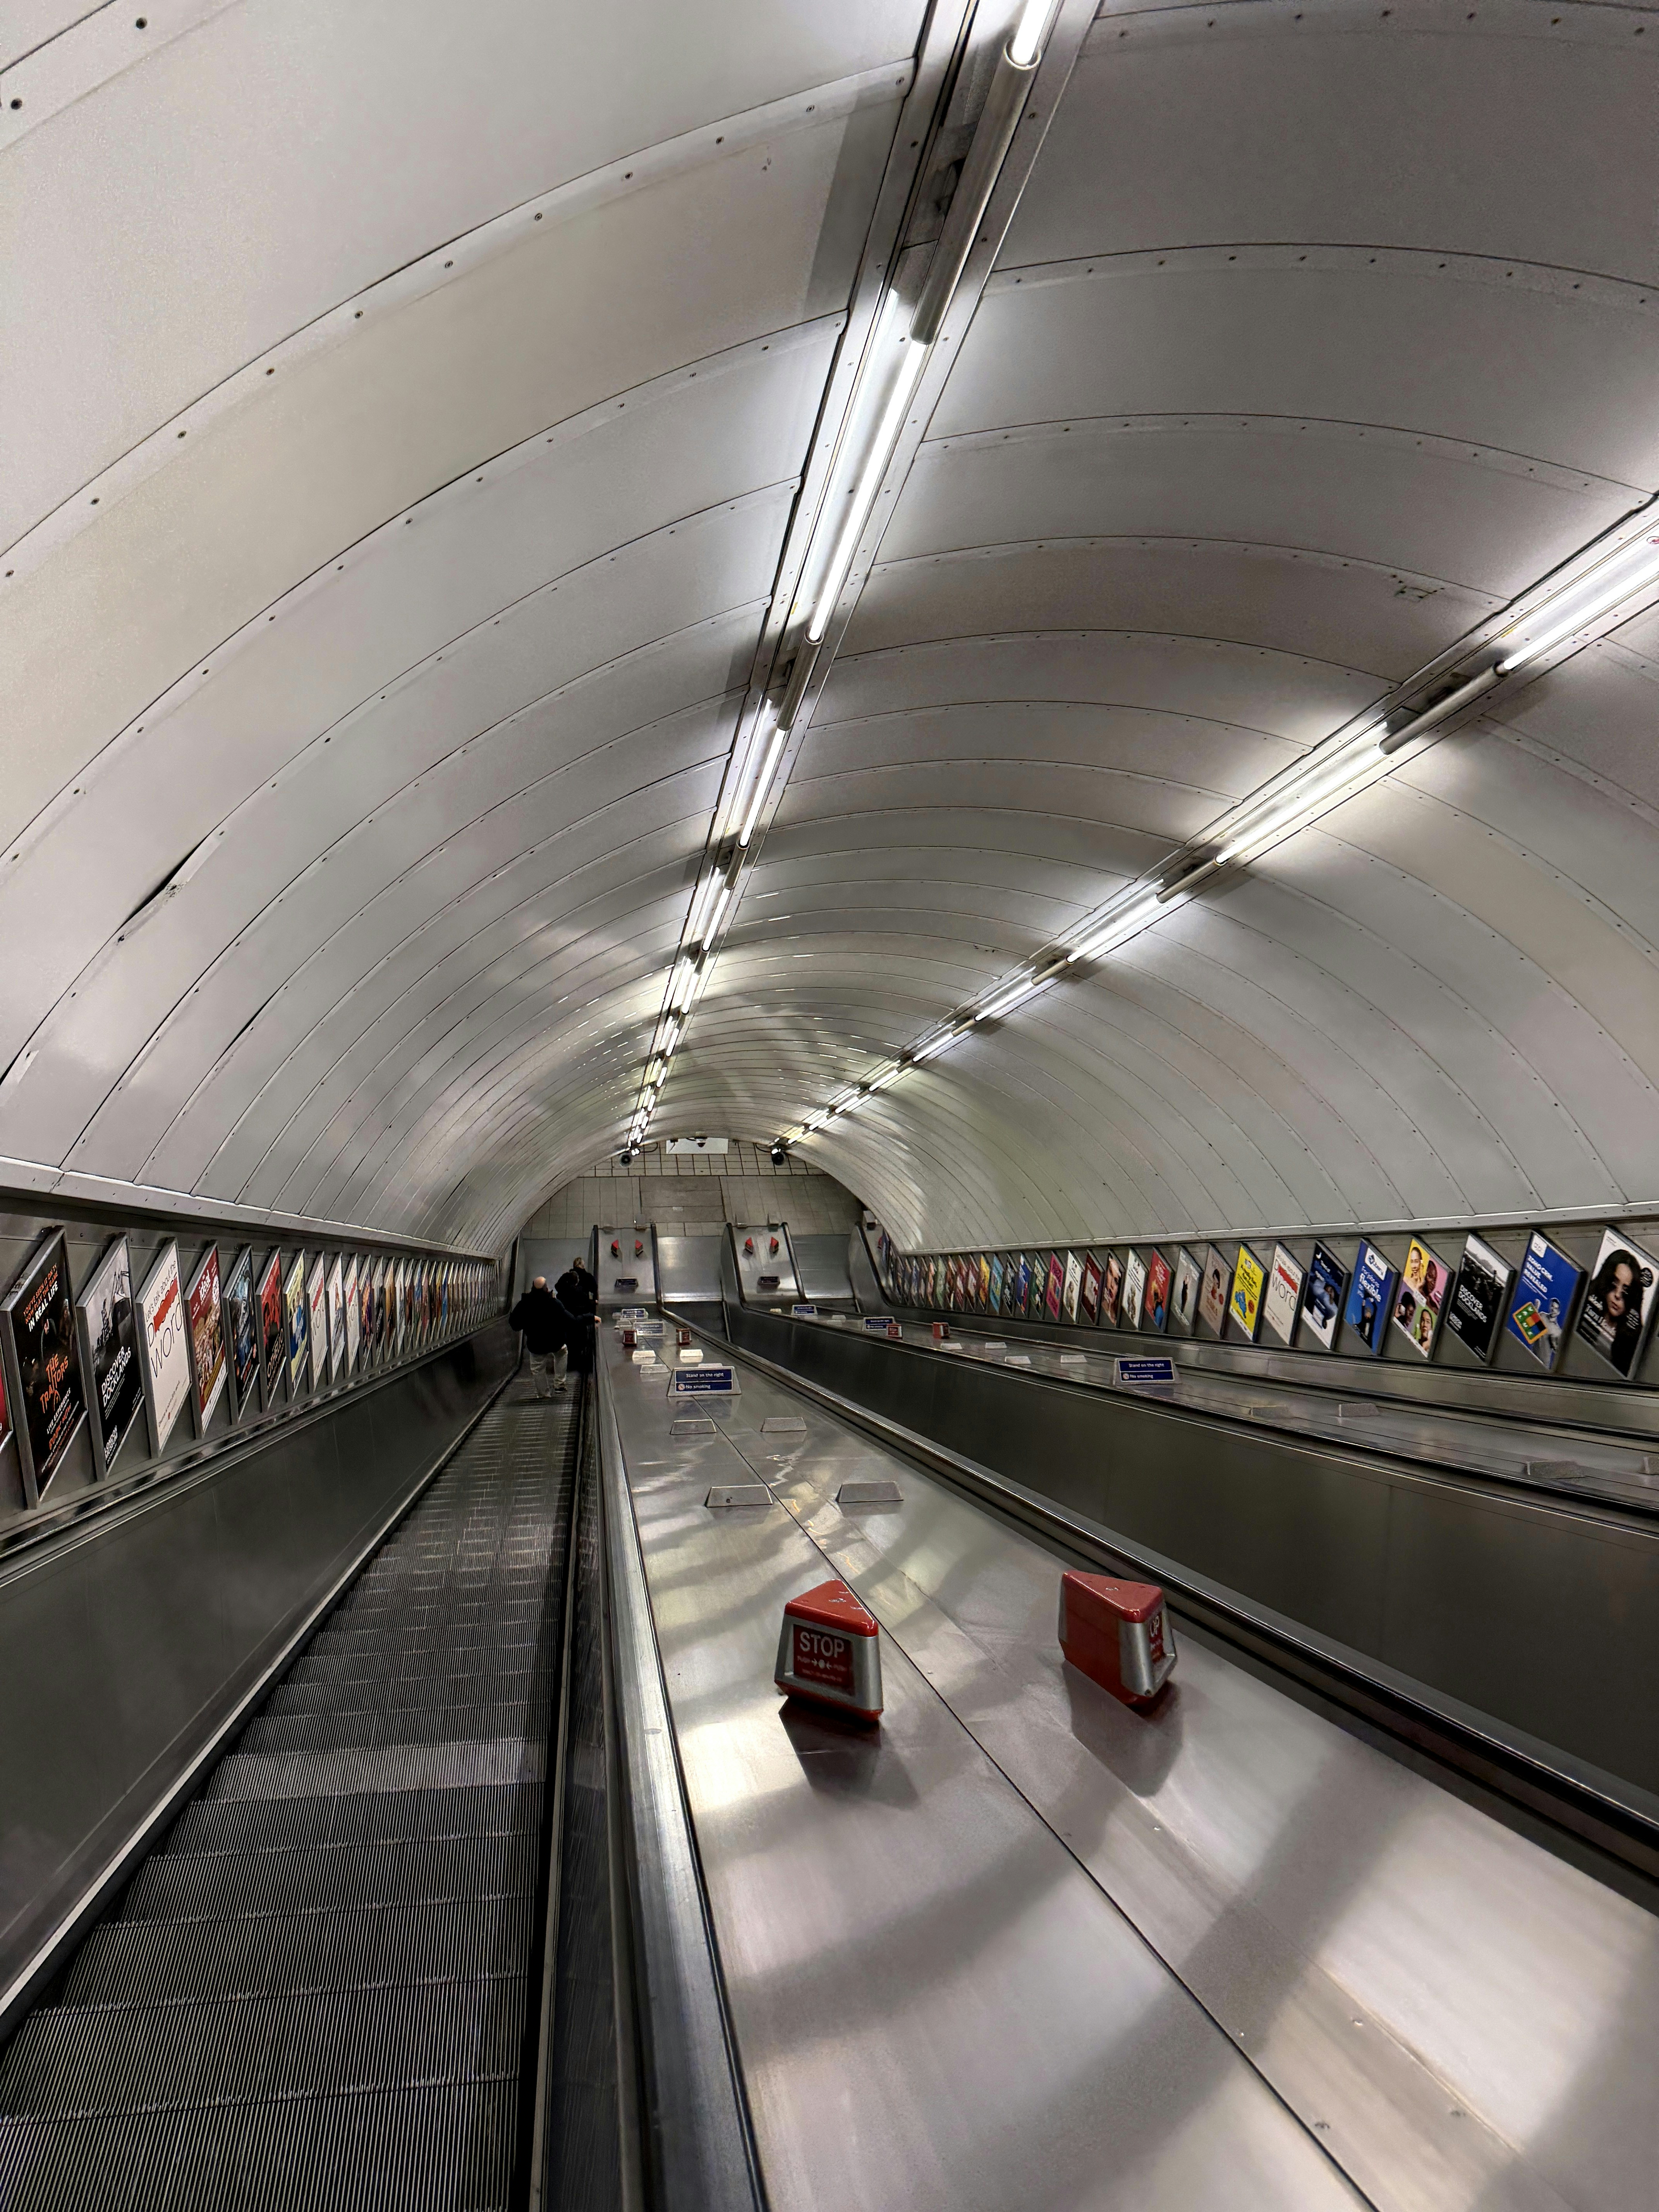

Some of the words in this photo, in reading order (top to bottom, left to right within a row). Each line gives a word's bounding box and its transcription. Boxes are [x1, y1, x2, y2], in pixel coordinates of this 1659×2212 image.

[29, 1317, 35, 1332] IN
[35, 1298, 48, 1322] REAL
[48, 1281, 58, 1302] LIFE
[145, 1304, 154, 1322] Let's
[160, 1269, 170, 1294] about
[1359, 1273, 1381, 1302] flexible
[1460, 1284, 1483, 1311] DISCOVER
[151, 1293, 182, 1378] word
[40, 1356, 69, 1413] TRAITORS
[46, 1353, 58, 1383] THE
[101, 1346, 124, 1395] DISCOVER
[103, 1347, 131, 1407] DOCKLANDS
[800, 1631, 845, 1658] STOP
[1150, 1615, 1160, 1638] OP
